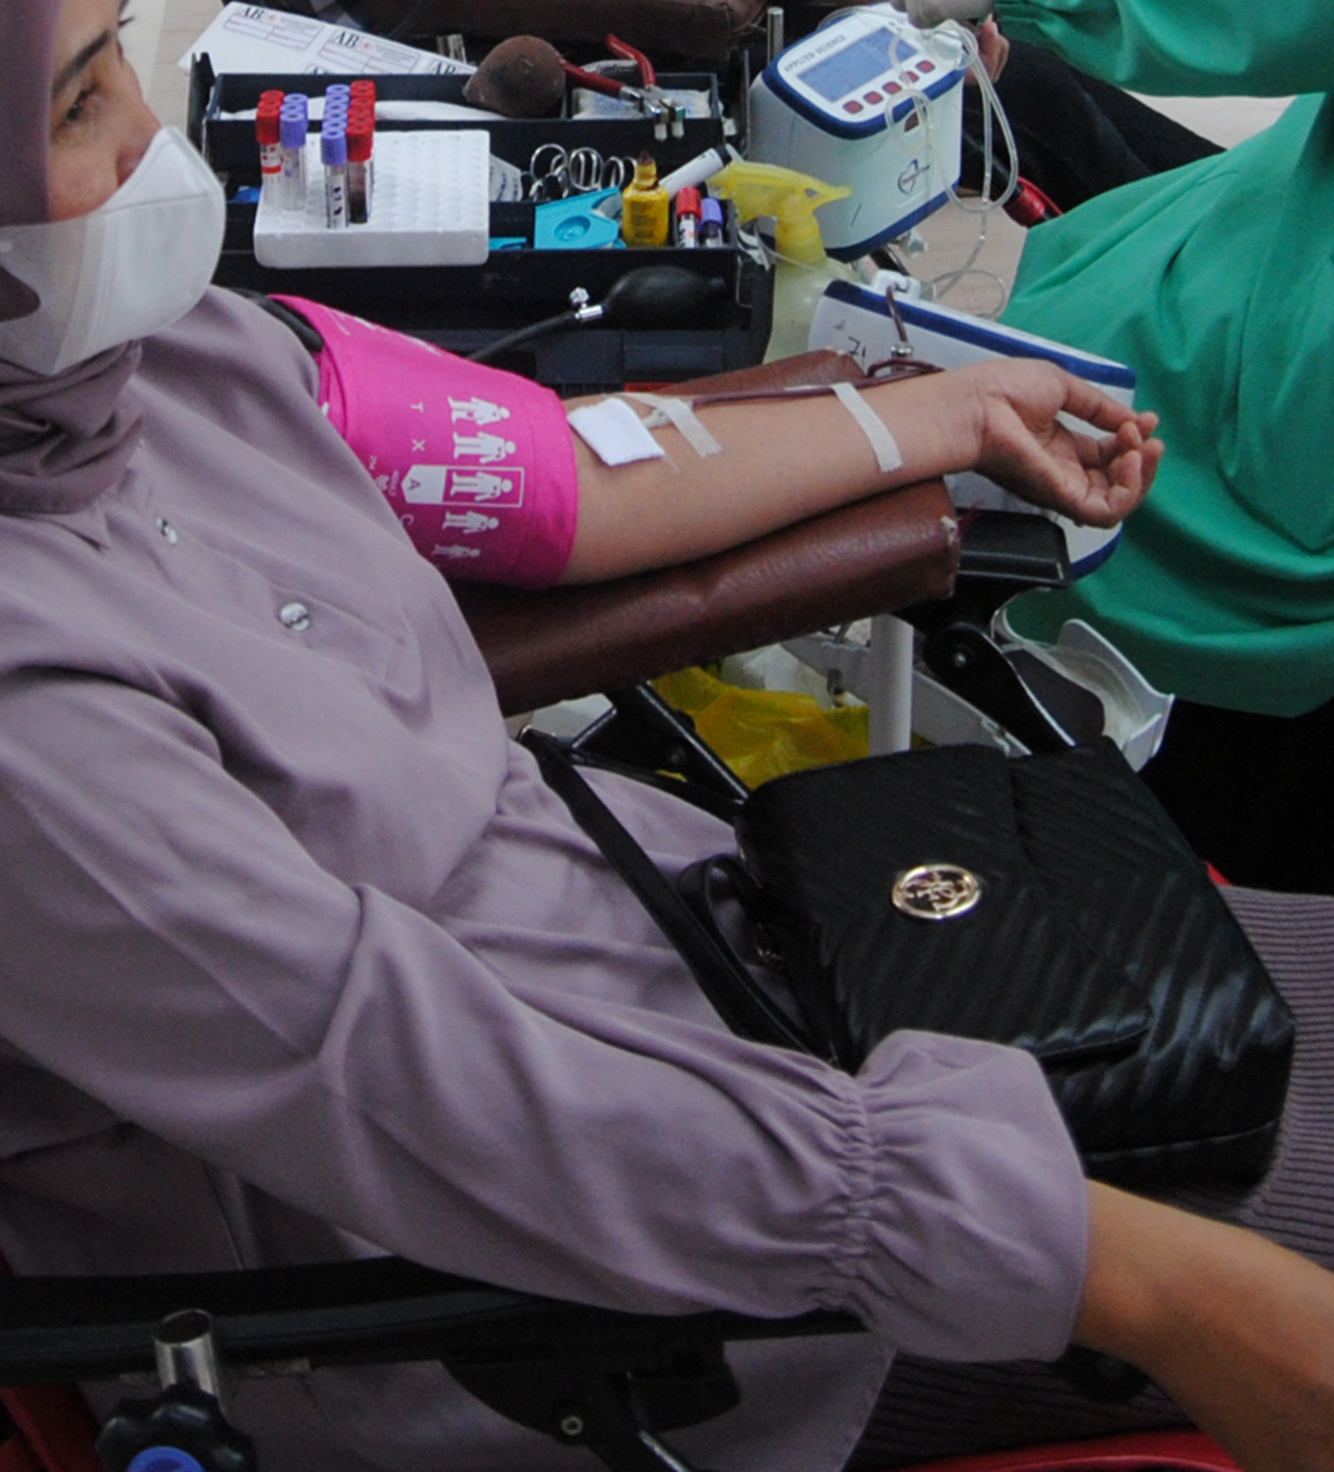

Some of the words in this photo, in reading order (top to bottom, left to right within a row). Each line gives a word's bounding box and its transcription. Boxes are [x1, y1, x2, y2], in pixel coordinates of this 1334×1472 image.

[239, 6, 265, 20] AB
[333, 30, 360, 48] AB
[784, 51, 815, 72] APPLIED
[816, 34, 846, 54] SCIENCE
[407, 478, 422, 491] A
